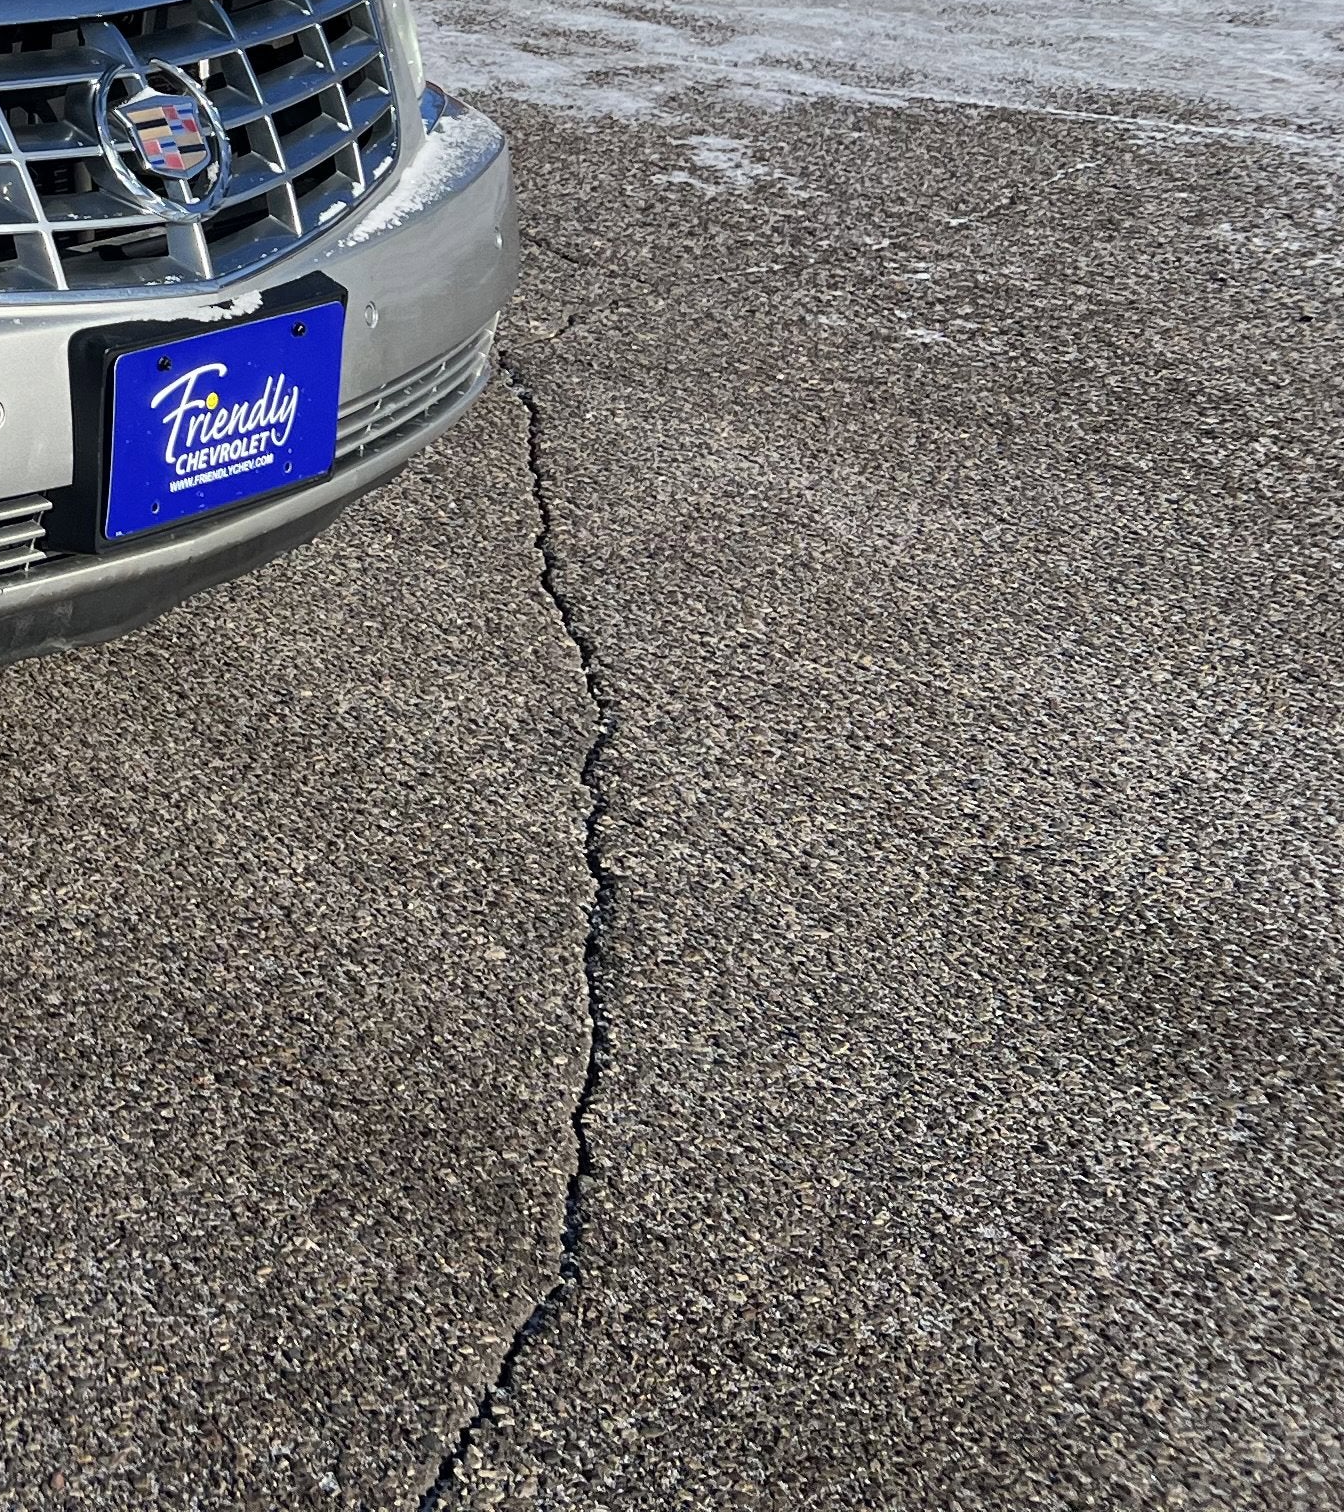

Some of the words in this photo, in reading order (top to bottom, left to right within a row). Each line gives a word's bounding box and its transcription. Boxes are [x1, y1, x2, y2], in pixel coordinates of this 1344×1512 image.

[151, 363, 299, 464] Friendly
[169, 453, 274, 493] WWW.FRIENDLYCHEV.COM
[175, 431, 270, 476] CHEVROLET
